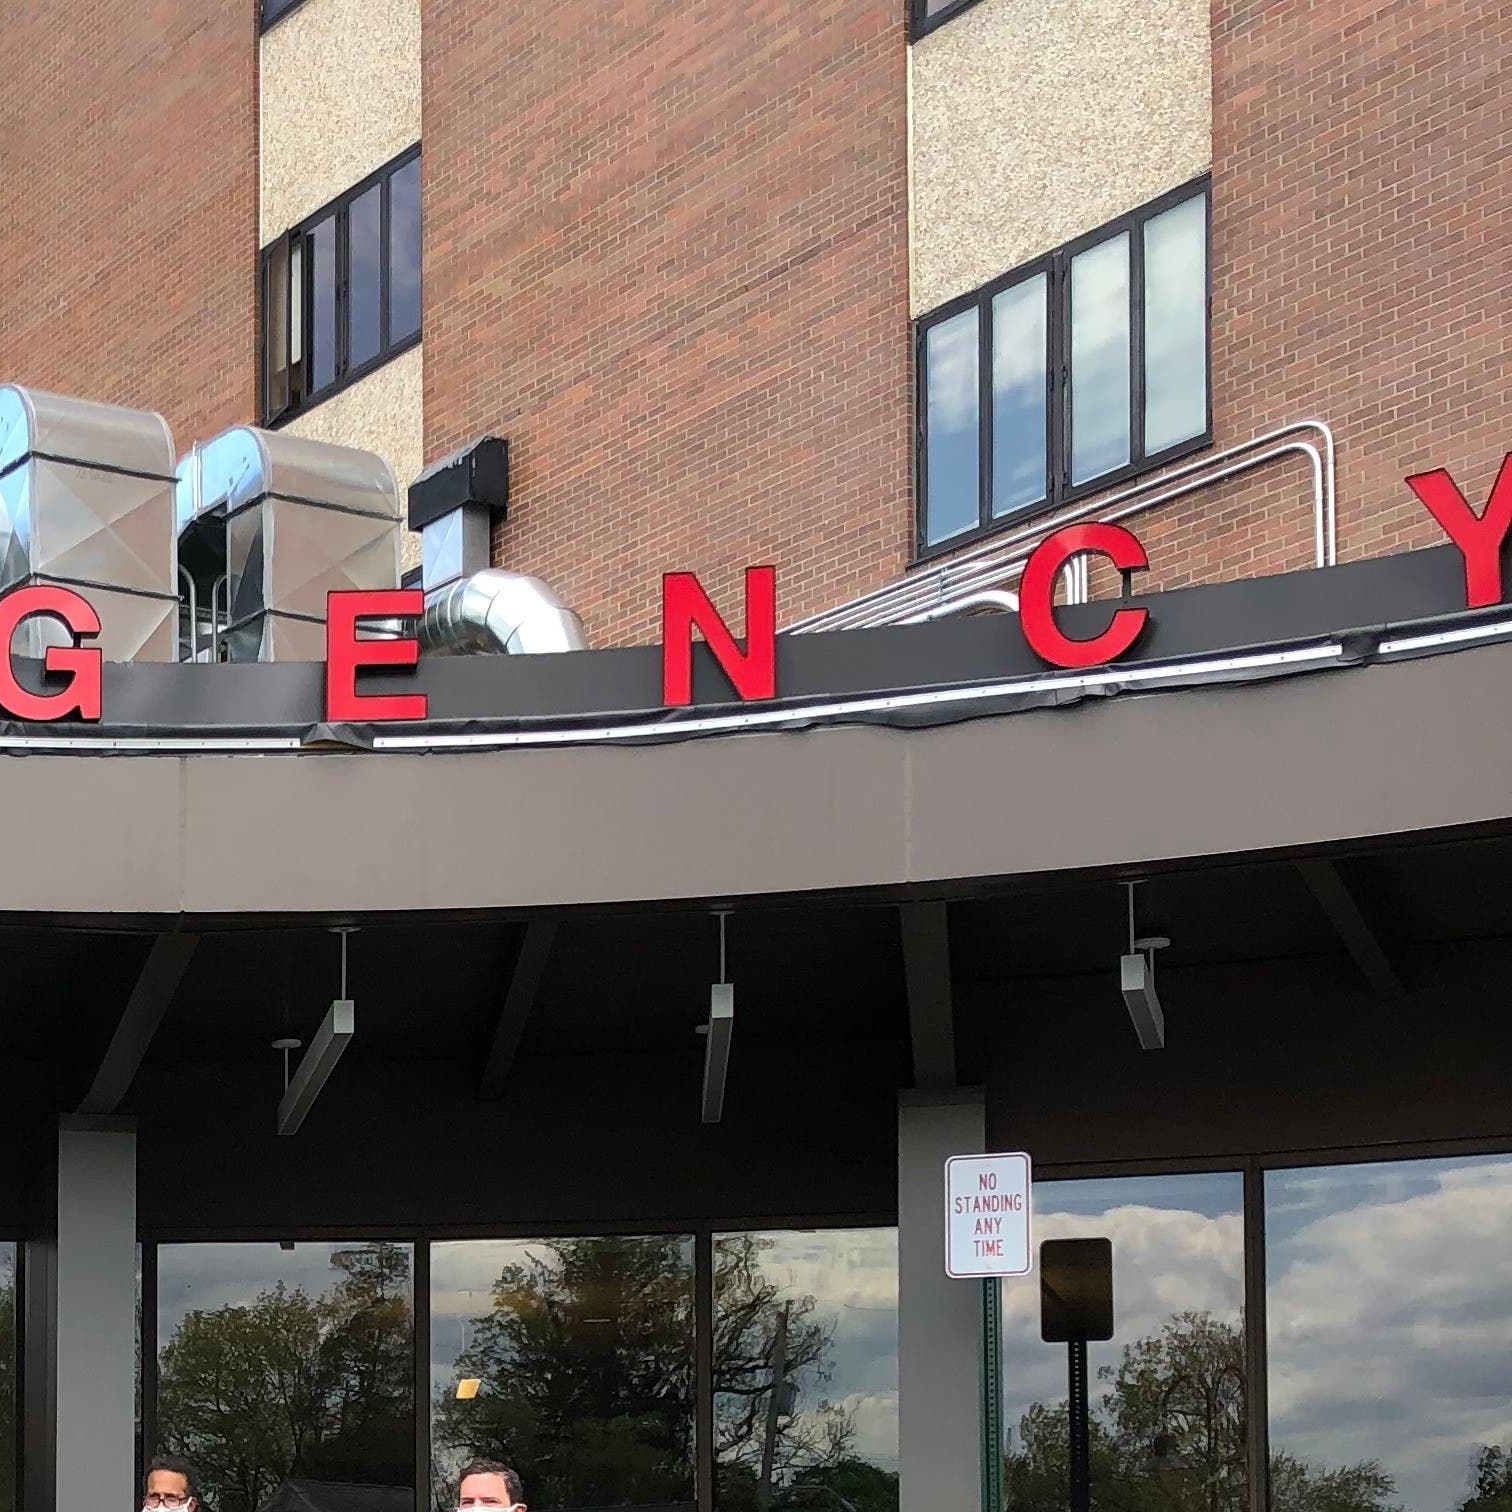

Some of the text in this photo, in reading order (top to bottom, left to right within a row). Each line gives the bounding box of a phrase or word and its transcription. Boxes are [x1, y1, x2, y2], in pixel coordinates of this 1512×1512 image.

[978, 1172, 997, 1191] NO
[954, 1193, 1022, 1214] STANDING
[974, 1216, 1003, 1235] ANY
[973, 1239, 1004, 1258] TIME
